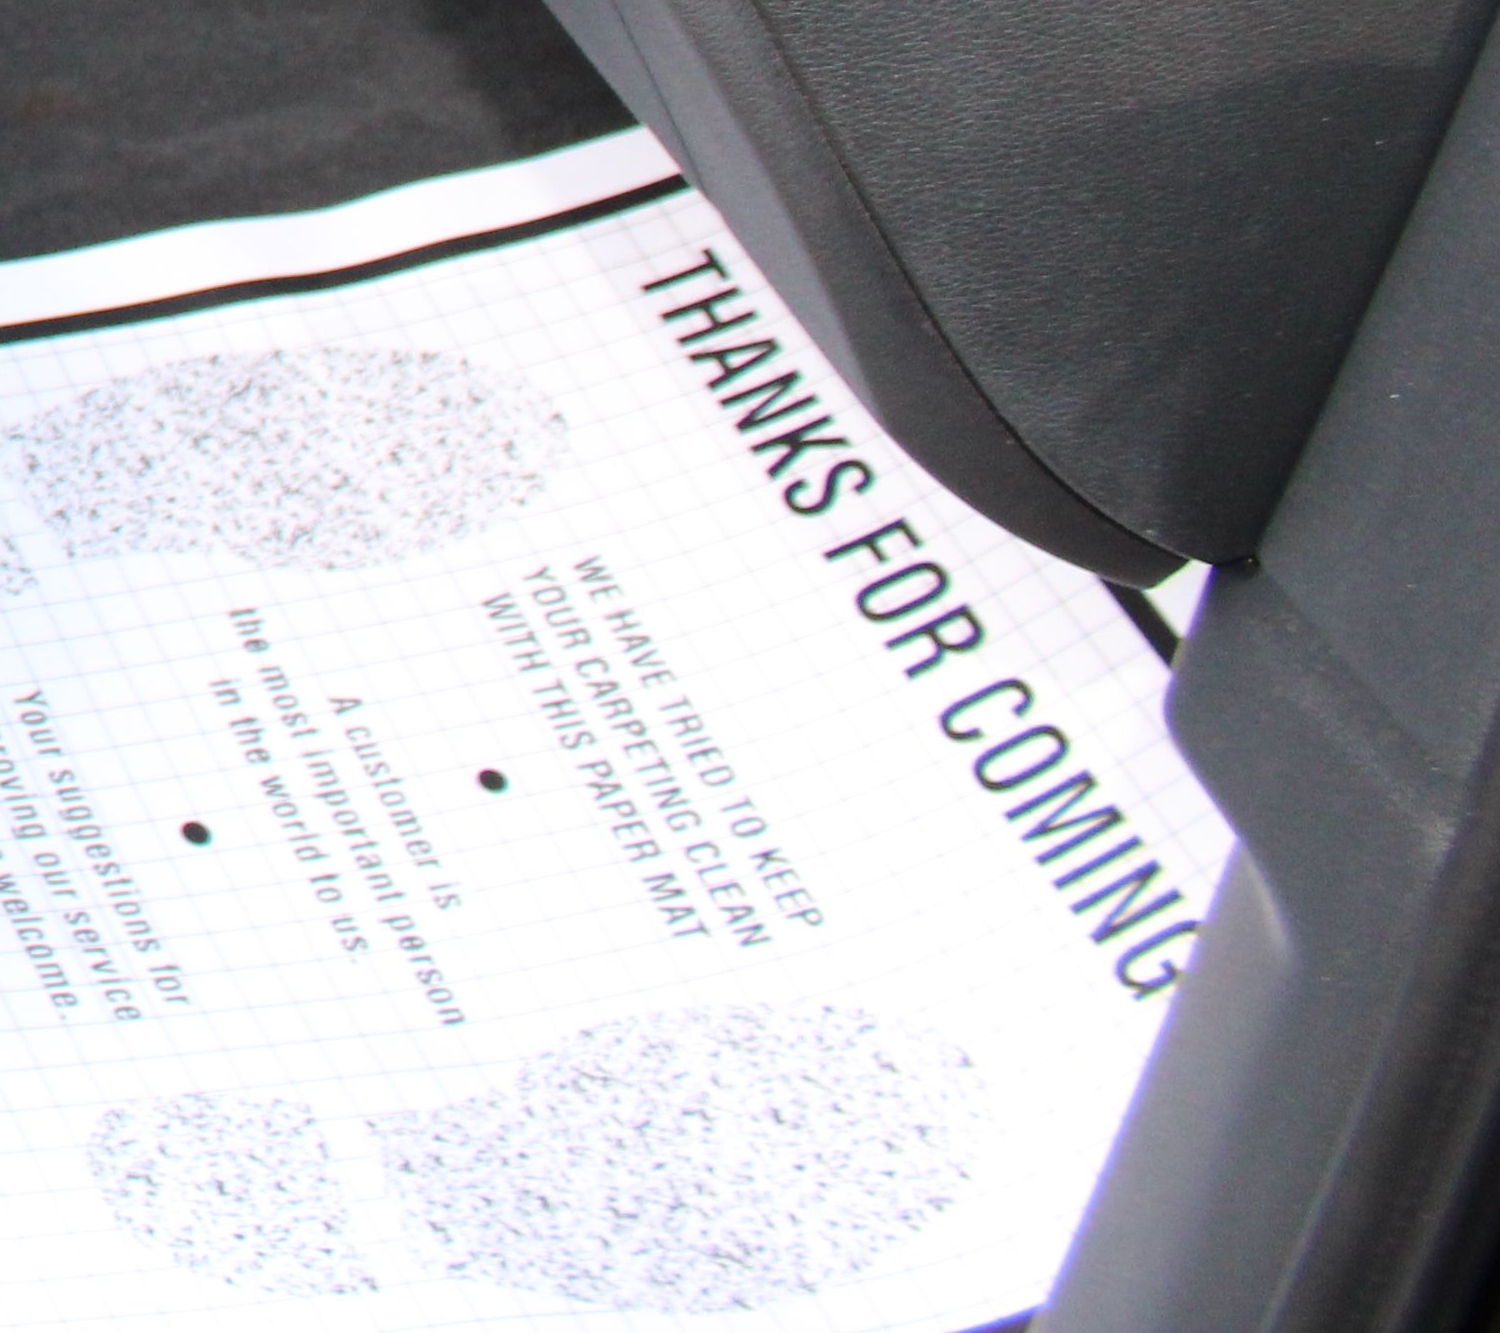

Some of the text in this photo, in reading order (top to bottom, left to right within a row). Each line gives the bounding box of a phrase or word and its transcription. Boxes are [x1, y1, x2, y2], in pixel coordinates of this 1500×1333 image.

[209, 678, 242, 707] in
[229, 716, 271, 764] the
[261, 775, 327, 863] world
[310, 873, 343, 904] to
[481, 593, 712, 938] WITH THIS PAPER MAT
[523, 566, 771, 947] YOUR CARPETING CLEAN
[573, 555, 824, 927] WE HAVE TRIED TO KEEP
[641, 250, 1198, 1001] THANKS FOR COMING
[13, 690, 190, 1006] Your suggestions for
[33, 853, 79, 898] our
[65, 910, 142, 1022] service
[228, 608, 467, 1026] the most important person
[329, 696, 462, 910] A customer is
